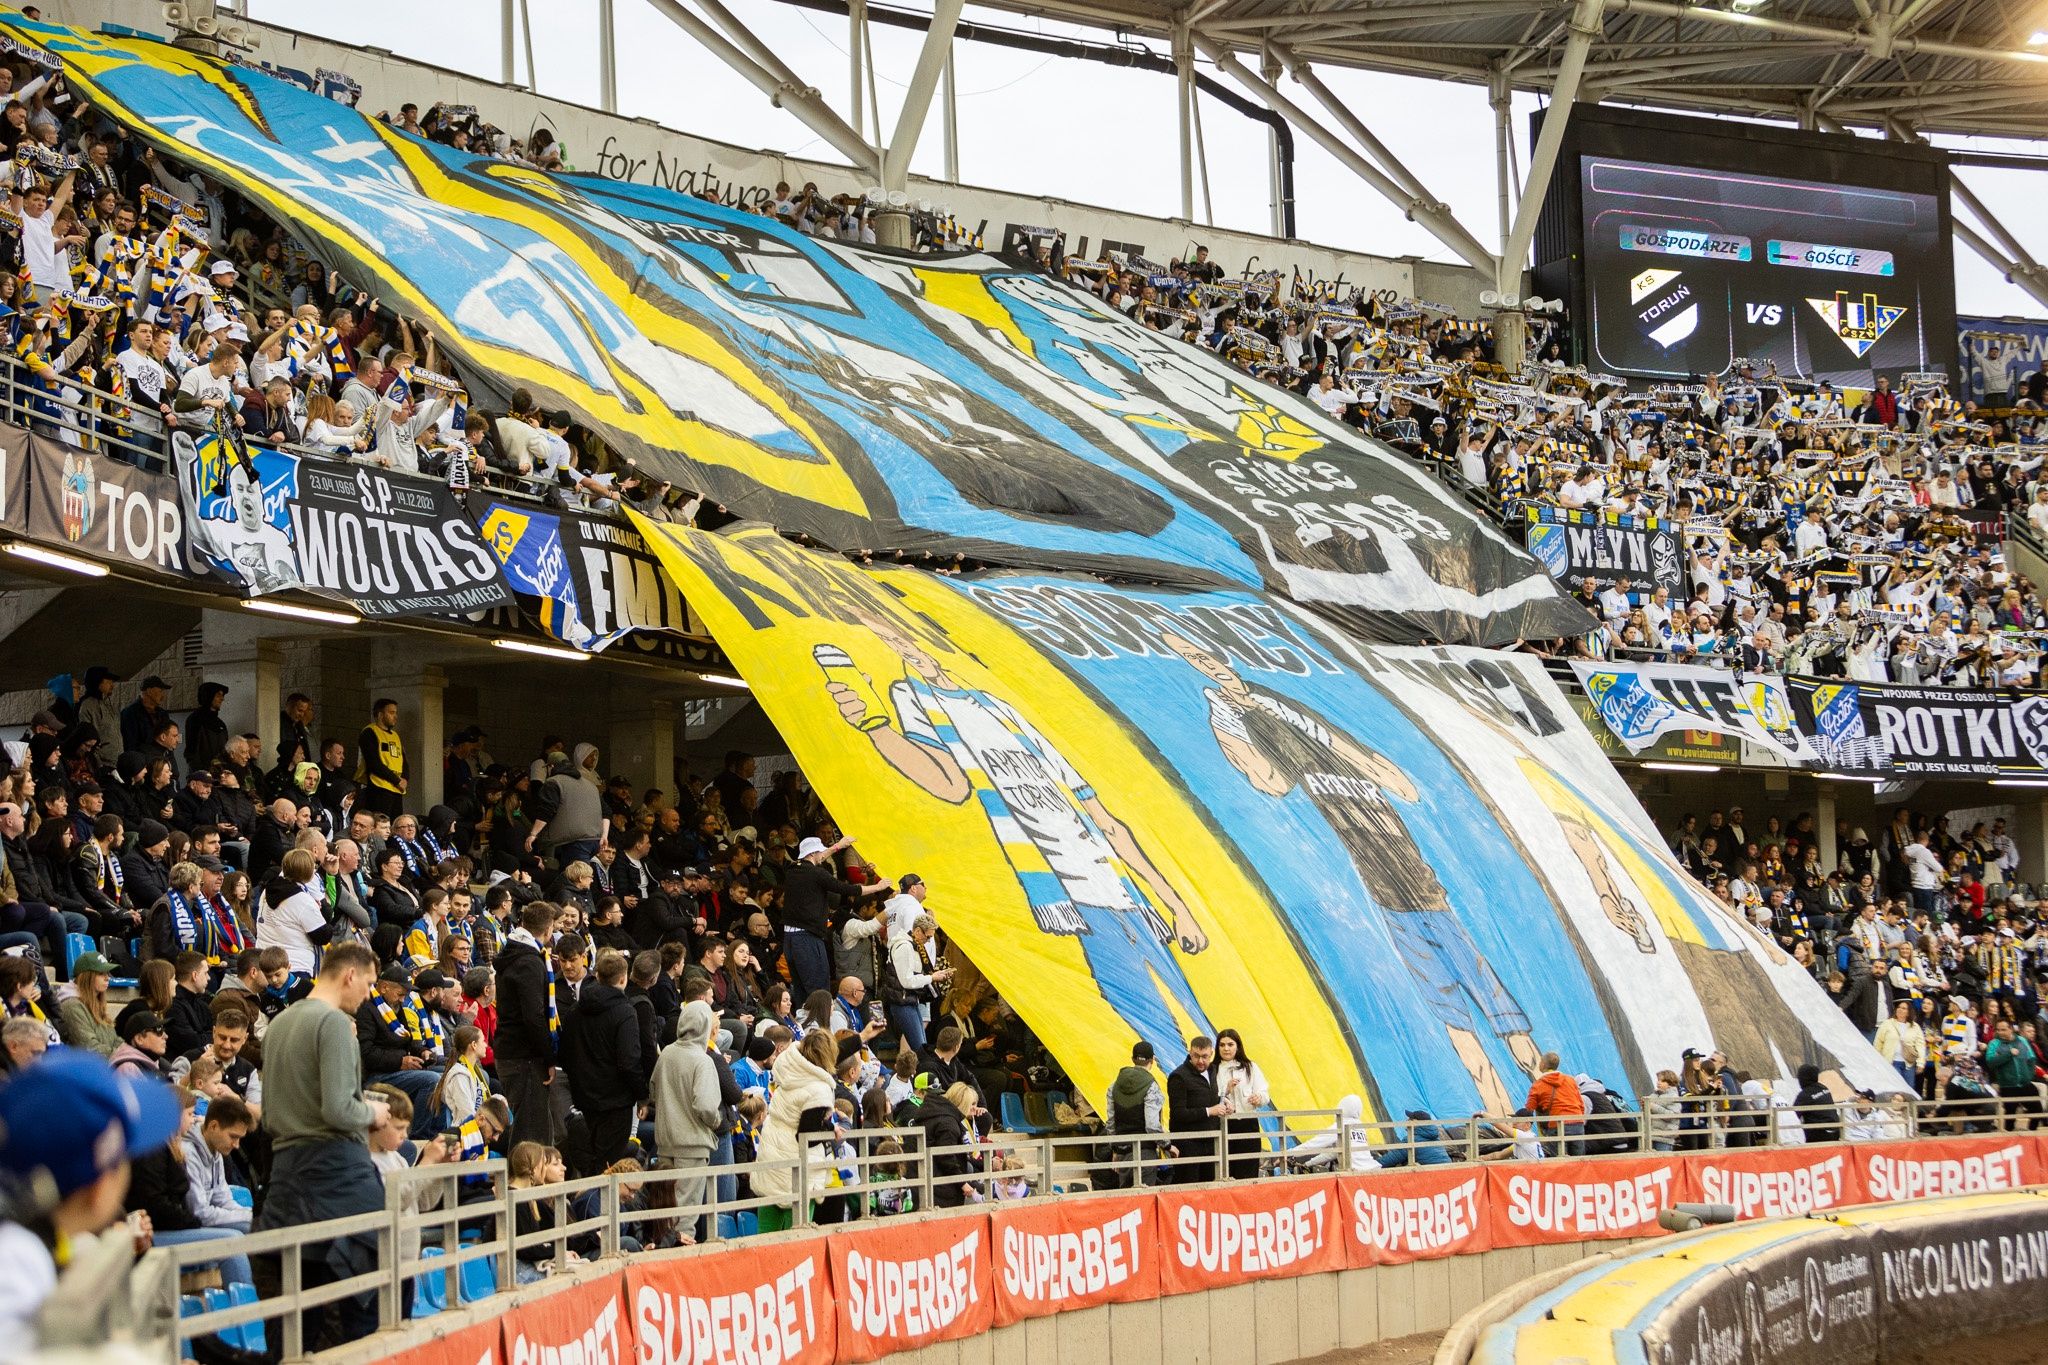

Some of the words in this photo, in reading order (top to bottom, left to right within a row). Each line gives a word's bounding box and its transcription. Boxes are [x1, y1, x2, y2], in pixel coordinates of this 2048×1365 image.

[597, 136, 646, 183] for
[653, 150, 771, 207] Nature
[1635, 233, 1740, 255] GOSPODARZE
[1804, 250, 1861, 267] GOŚCIE
[1636, 275, 1655, 291] KS
[1639, 284, 1690, 323] TORUŃ
[1746, 303, 1783, 325] VS
[309, 475, 357, 497] 23.04.1969
[356, 467, 396, 516] Ś.P.
[395, 491, 435, 511] 14.12.2021
[289, 503, 497, 594] WOJTAS
[378, 599, 400, 615] W
[398, 594, 451, 611] NASZEJ
[446, 582, 508, 610] PAMIĘCI
[1881, 688, 1922, 700] WPOJONE
[1924, 690, 1954, 702] PRZEZ
[1875, 704, 2017, 758] ROTKI
[1906, 762, 1923, 773] KIM
[1925, 763, 1946, 773] JEST
[1947, 764, 1970, 774] NASZ
[1972, 761, 1999, 774] WRÓG
[1508, 1166, 1673, 1233] SUPERBET
[1702, 1155, 1845, 1219] SUPERBET
[1869, 1144, 2025, 1201] SUPERBET
[1177, 1189, 1327, 1273] SUPERBET
[1354, 1177, 1478, 1252] SUPERBET
[846, 1228, 980, 1338] SUPERBET
[1003, 1207, 1143, 1302] SUPERBET
[1882, 1237, 1995, 1303] NICOLAUS
[637, 1255, 816, 1365] SUPERBET
